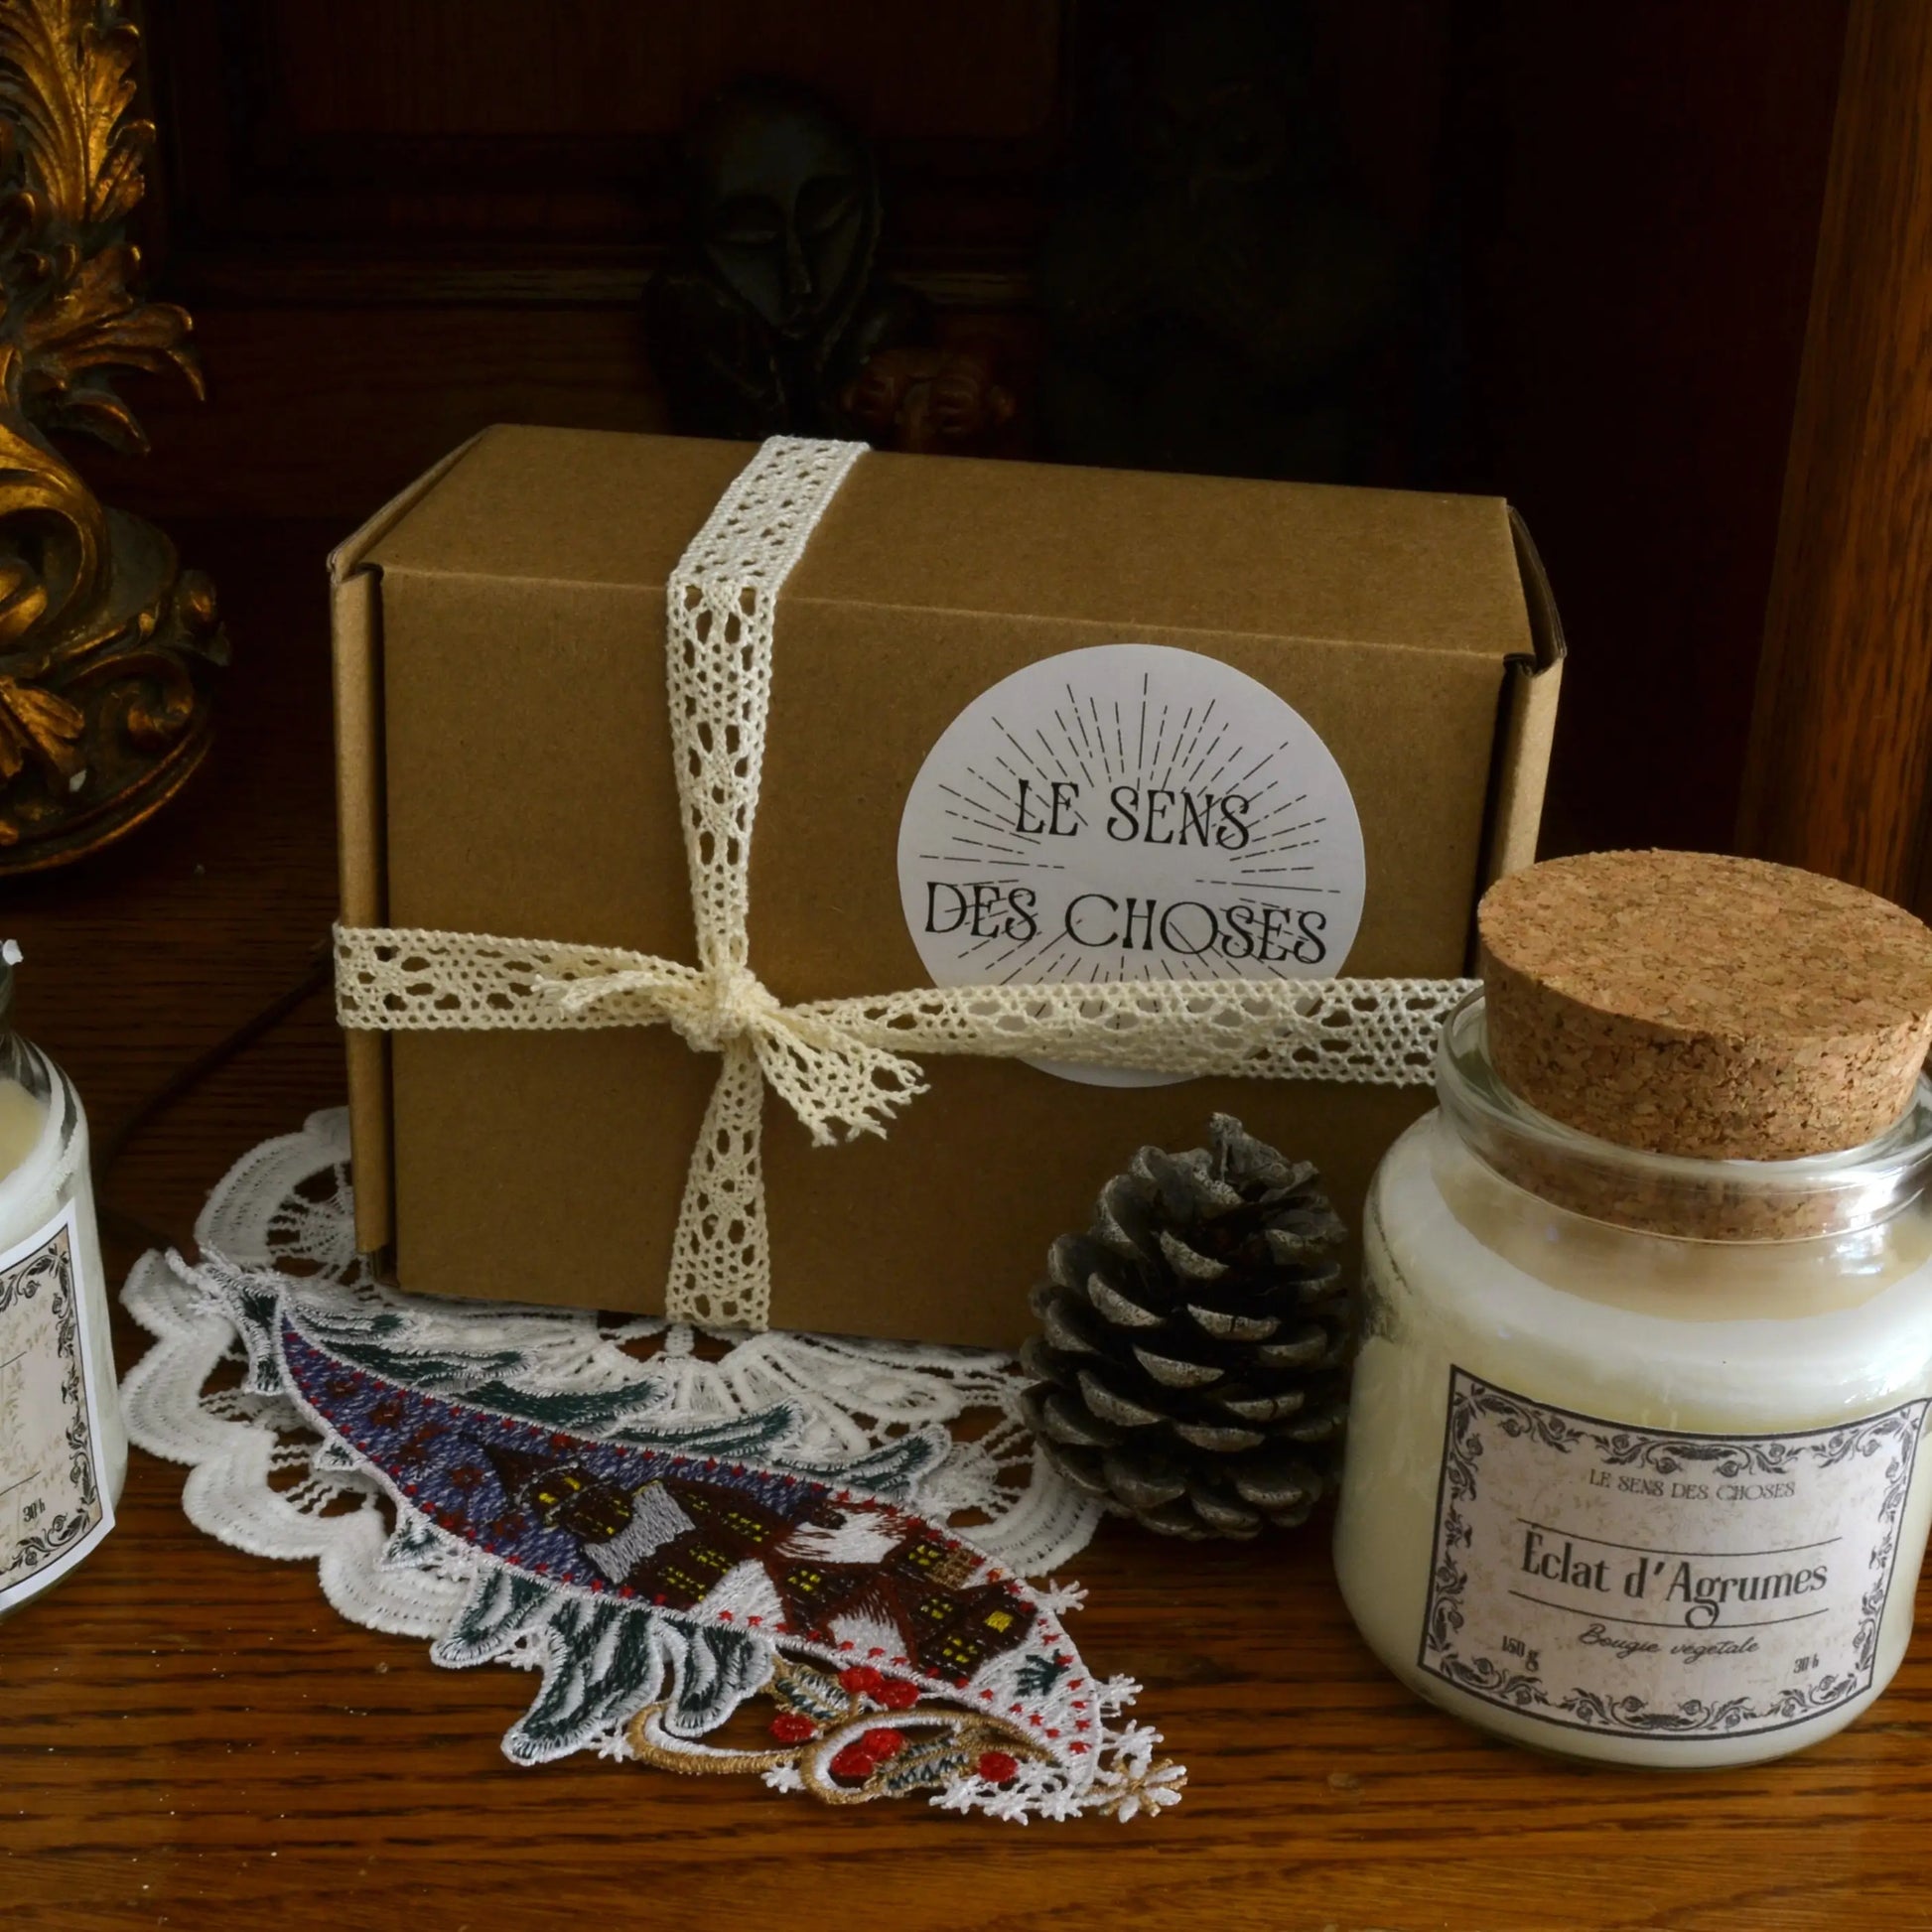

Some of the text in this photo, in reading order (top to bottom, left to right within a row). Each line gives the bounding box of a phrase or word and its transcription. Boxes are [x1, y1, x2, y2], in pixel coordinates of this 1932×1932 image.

[1015, 778, 1250, 850] LE SENS
[924, 881, 1327, 964] DES CHOSES
[1588, 1468, 1796, 1501] LE SENS DES CHOSES
[1622, 1556, 1828, 1630] d'Agrumes
[1578, 1622, 1661, 1660] Bougie
